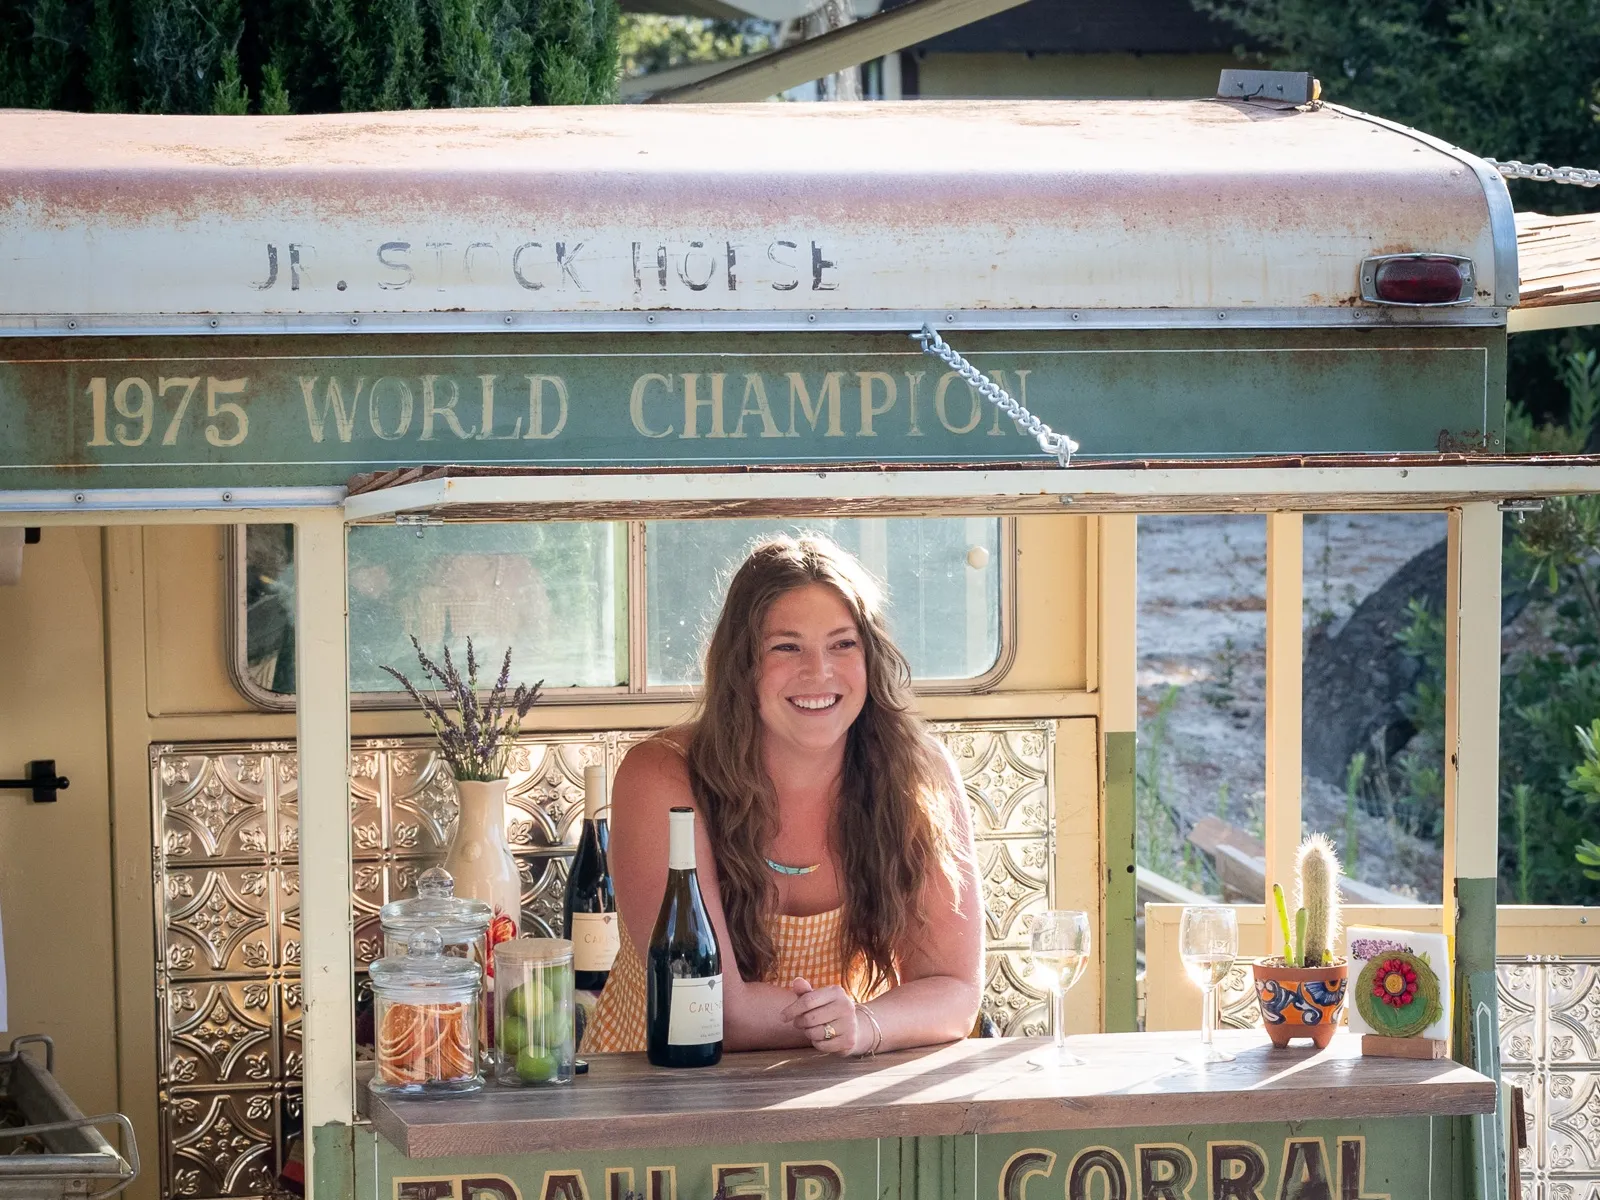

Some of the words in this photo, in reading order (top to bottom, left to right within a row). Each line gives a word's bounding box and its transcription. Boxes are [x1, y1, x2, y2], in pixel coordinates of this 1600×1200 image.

[87, 376, 251, 448] 1975
[299, 373, 569, 443] WORLD
[629, 369, 1032, 439] CHAMPION
